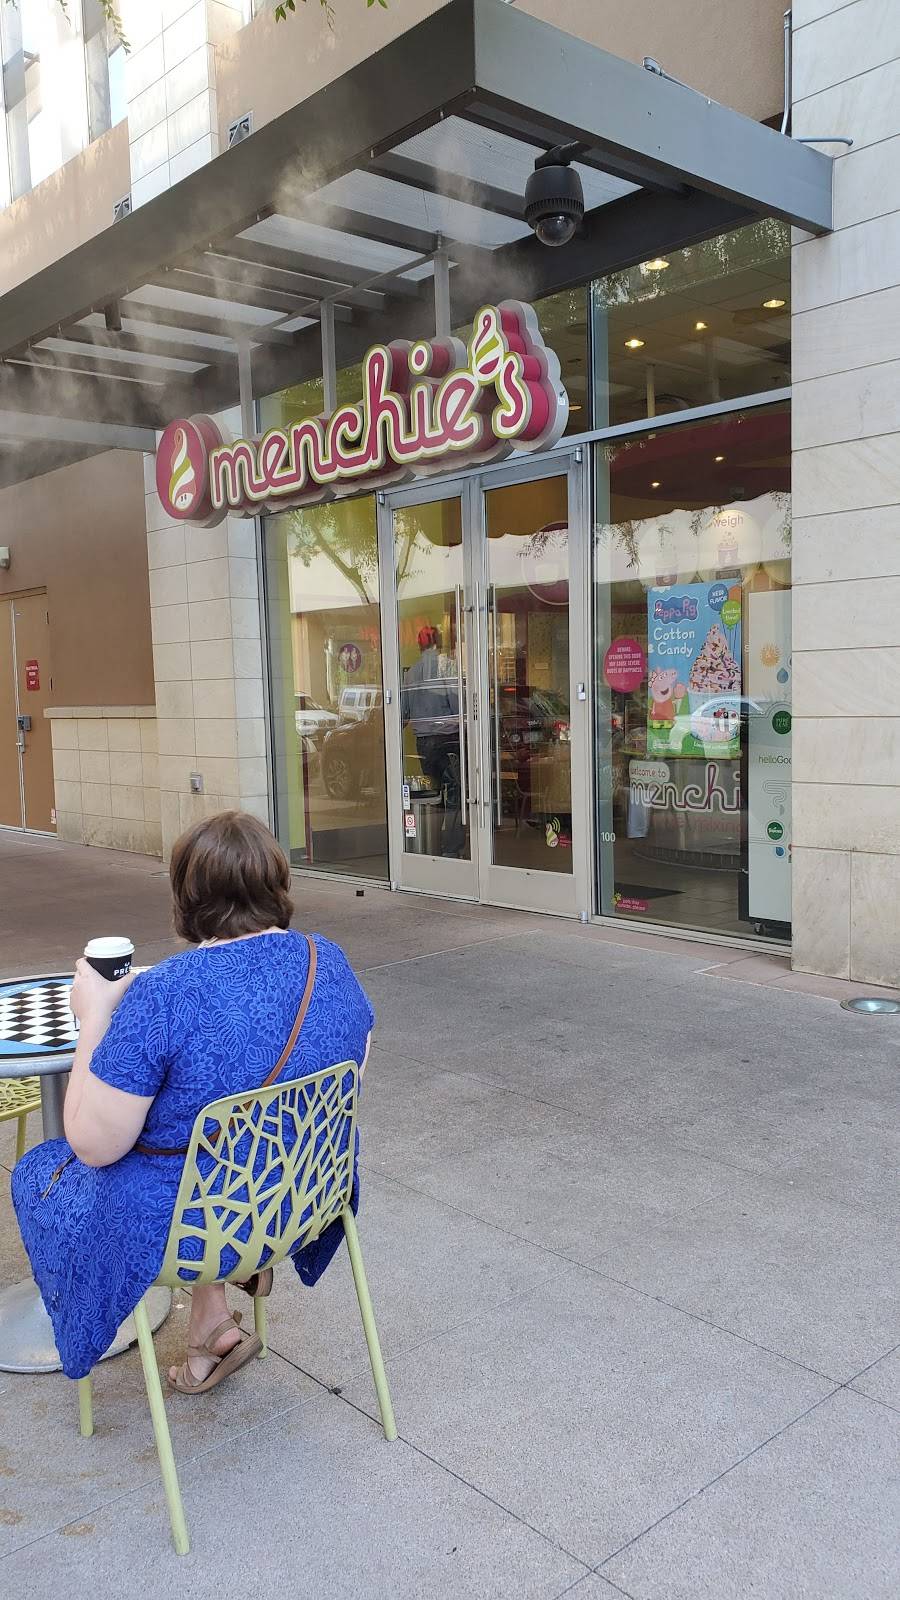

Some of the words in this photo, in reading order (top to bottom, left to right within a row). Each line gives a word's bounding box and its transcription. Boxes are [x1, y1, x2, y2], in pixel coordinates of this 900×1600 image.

[209, 303, 532, 510] menchie's
[713, 514, 743, 528] weigh
[655, 601, 681, 621] Peppa
[682, 598, 697, 618] Pig
[653, 627, 695, 641] Cotton
[657, 641, 693, 658] Candy
[630, 765, 656, 776] welcome
[657, 768, 666, 778] to
[600, 831, 616, 842] 100
